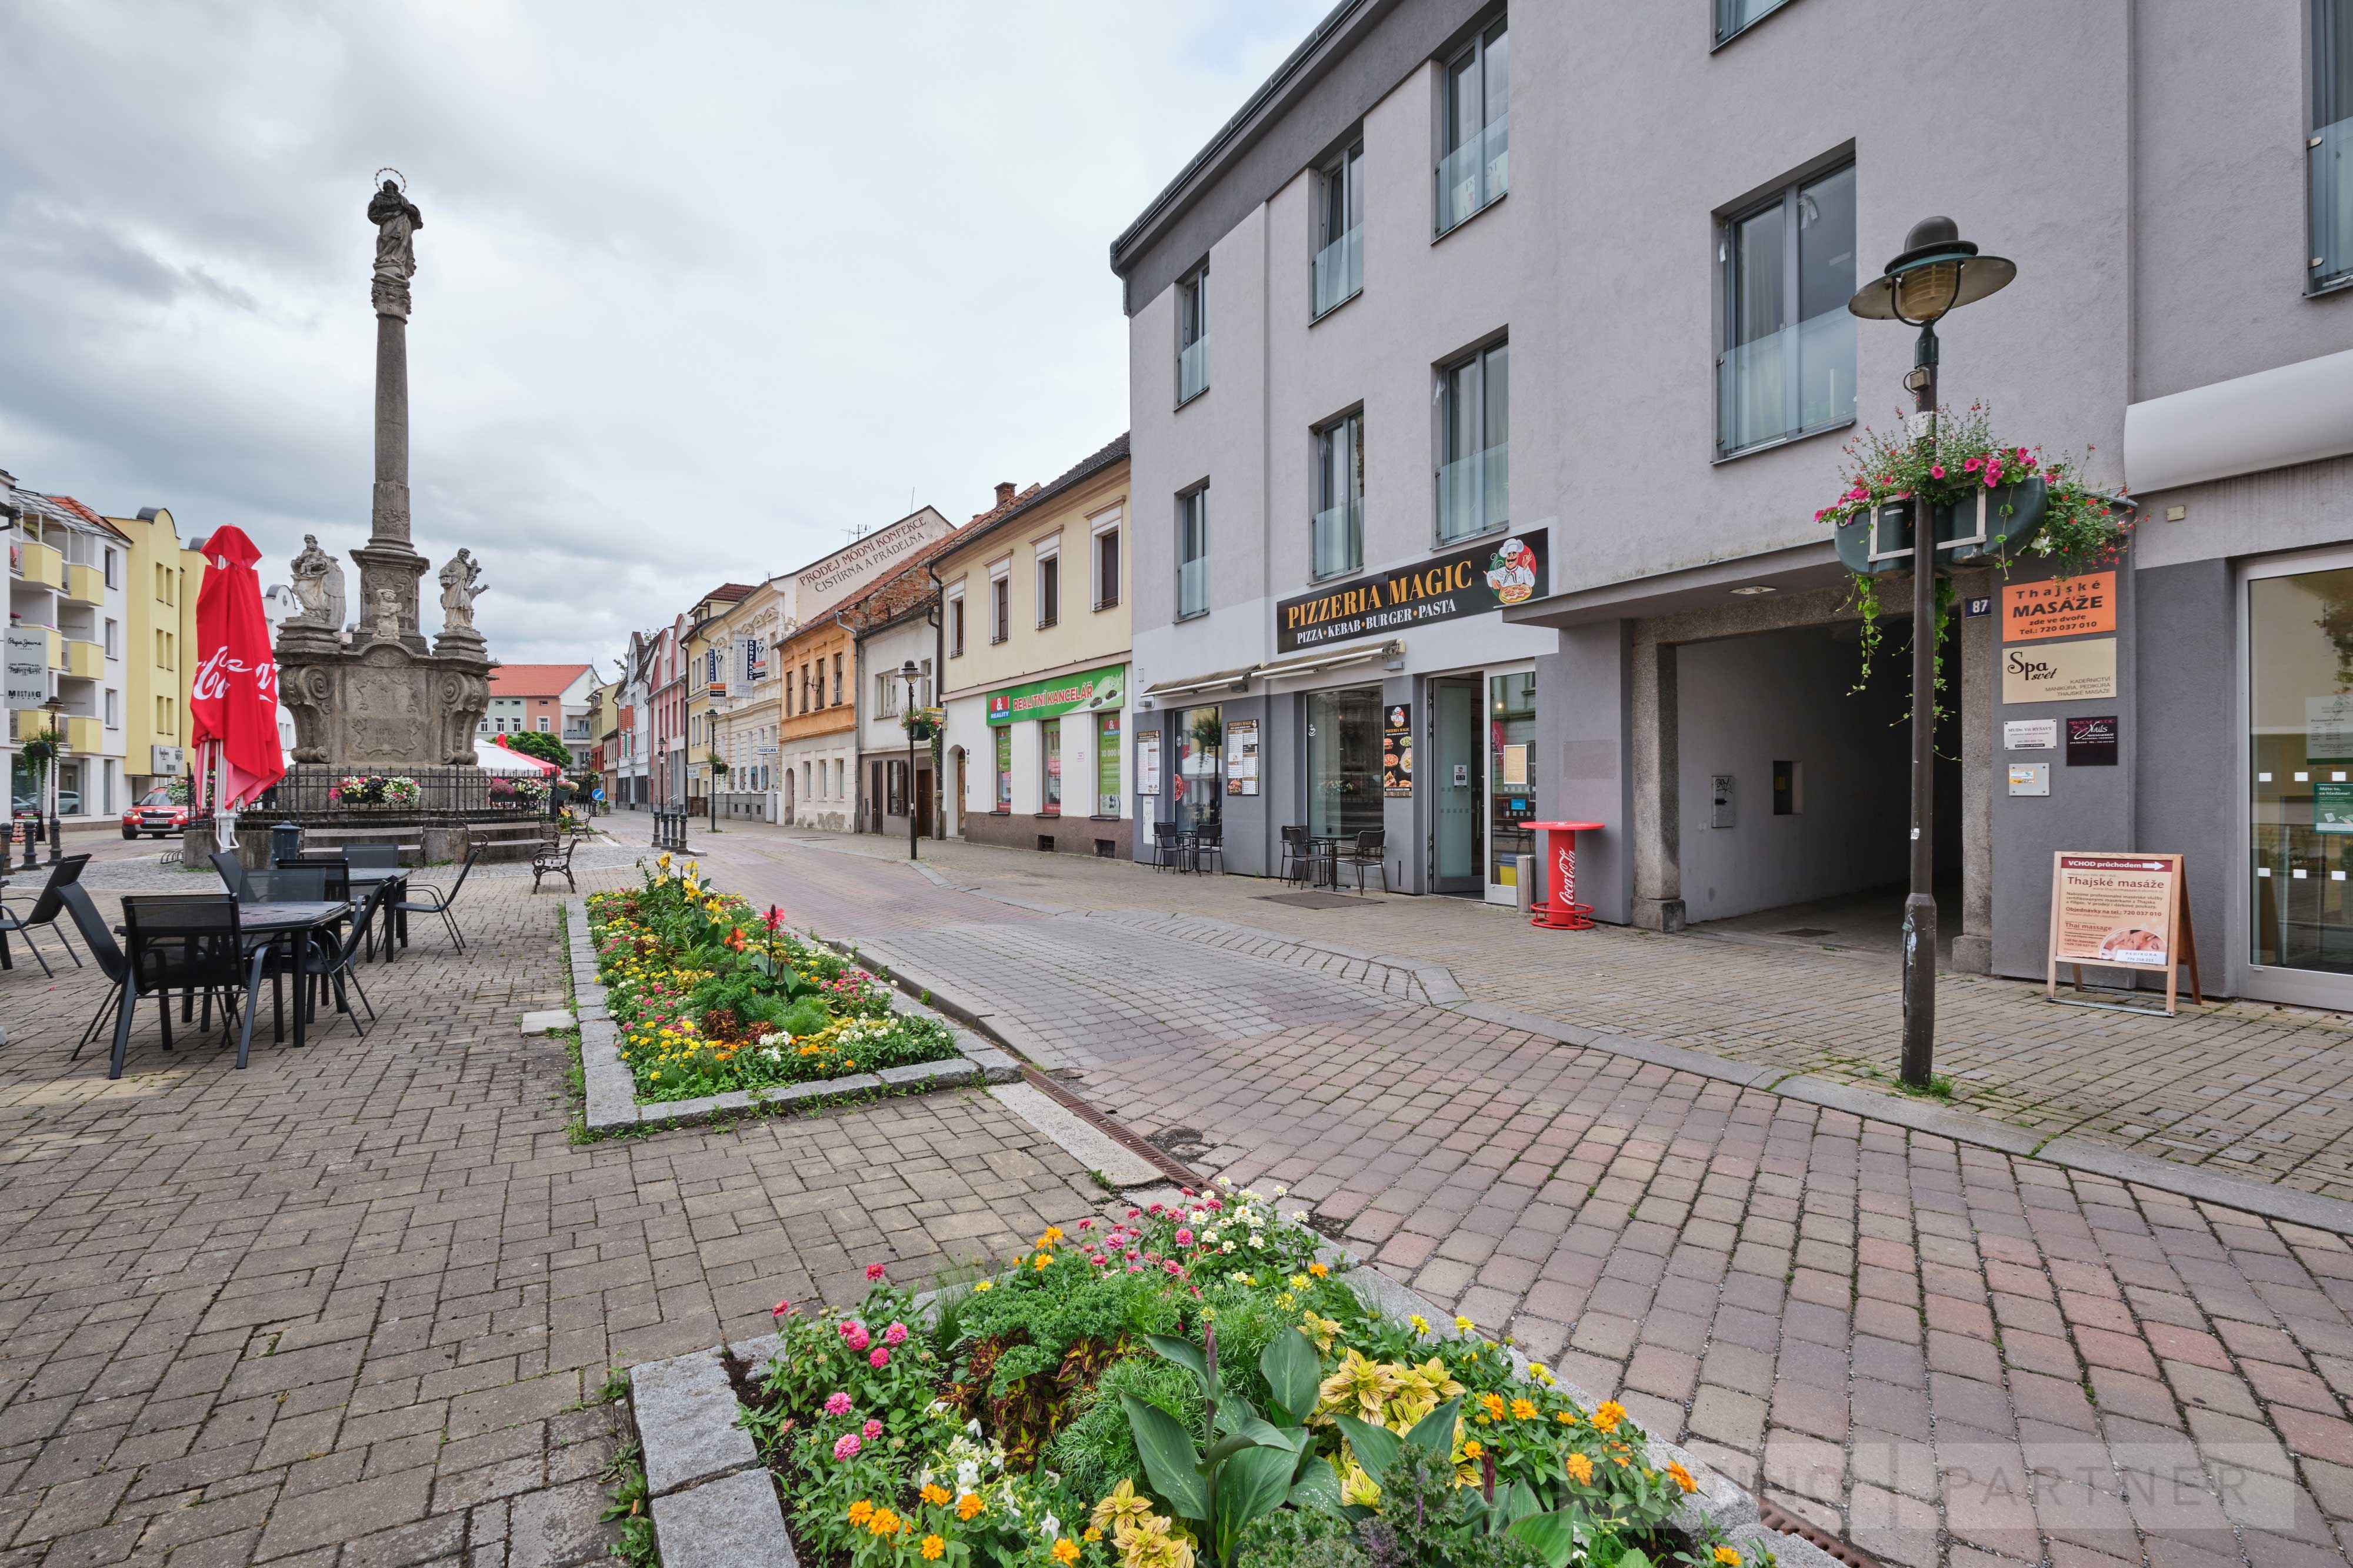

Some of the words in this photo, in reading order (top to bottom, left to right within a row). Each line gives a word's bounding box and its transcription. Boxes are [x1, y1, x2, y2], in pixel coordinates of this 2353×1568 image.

[799, 559, 840, 586] PRODEJ
[842, 541, 875, 565] MÓDNÍ
[876, 517, 926, 547] KONFEKCE
[815, 563, 864, 592] ČISTÍRNA
[866, 559, 873, 568] A
[873, 532, 925, 563] PRÁDELNA
[1288, 585, 1382, 629] PIZZERIA
[1389, 561, 1472, 605] MAGIC
[2016, 580, 2101, 599] Thajské
[1972, 599, 1988, 613] 87
[2013, 595, 2102, 618] MASÁŽE
[1297, 628, 1323, 644] PIZZA
[1328, 619, 1361, 638] KEBAB
[1366, 608, 1412, 630] BURGER
[1418, 599, 1456, 618] PASTA
[2008, 652, 2048, 680] Spa
[2032, 668, 2057, 680] svět
[1013, 690, 1046, 712] REALITNÍ
[1047, 681, 1094, 704] KANCELÁŘ
[2068, 877, 2113, 888] Thajské
[2118, 880, 2164, 889] masáže
